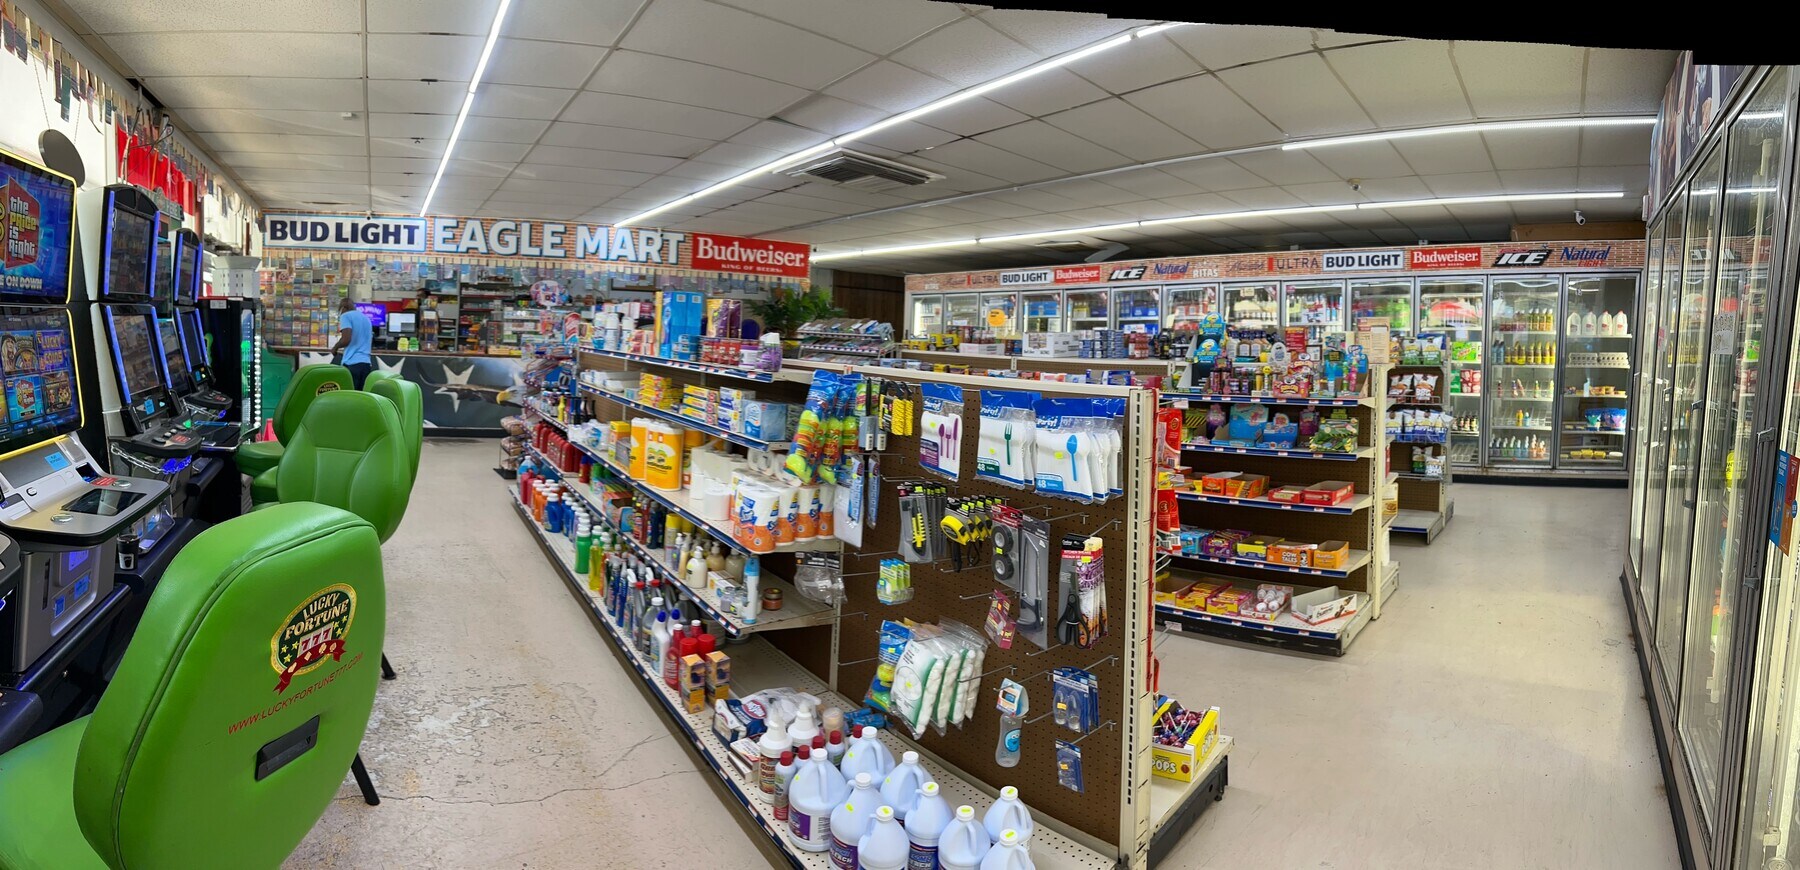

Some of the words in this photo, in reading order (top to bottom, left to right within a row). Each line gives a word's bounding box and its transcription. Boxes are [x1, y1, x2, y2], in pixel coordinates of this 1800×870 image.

[10, 196, 29, 213] the
[9, 225, 19, 240] is
[270, 220, 330, 242] BUD
[335, 222, 420, 245] LIGHT
[433, 217, 567, 257] EAGLE
[575, 224, 685, 265] MART
[697, 236, 804, 267] Budweiser
[1413, 250, 1479, 264] Budweiser
[1497, 252, 1546, 265] ICE
[1560, 246, 1612, 261] Natural
[1276, 258, 1320, 270] ULTRA
[1325, 255, 1356, 269] BUD
[1358, 252, 1401, 268] LIGHT
[1056, 268, 1099, 280] Budweiser
[1111, 267, 1144, 280] ICE
[1154, 262, 1190, 275] Natural
[1193, 268, 1219, 279] RITAS
[6, 275, 19, 287] ON
[19, 276, 43, 290] DOWN
[972, 275, 998, 284] ULTRA
[1002, 274, 1021, 283] BUD
[1022, 272, 1048, 282] LIGHT
[978, 463, 985, 472] 48
[1037, 479, 1046, 488] 48
[302, 592, 340, 622] LUCKY
[284, 598, 350, 641] FORTUNE
